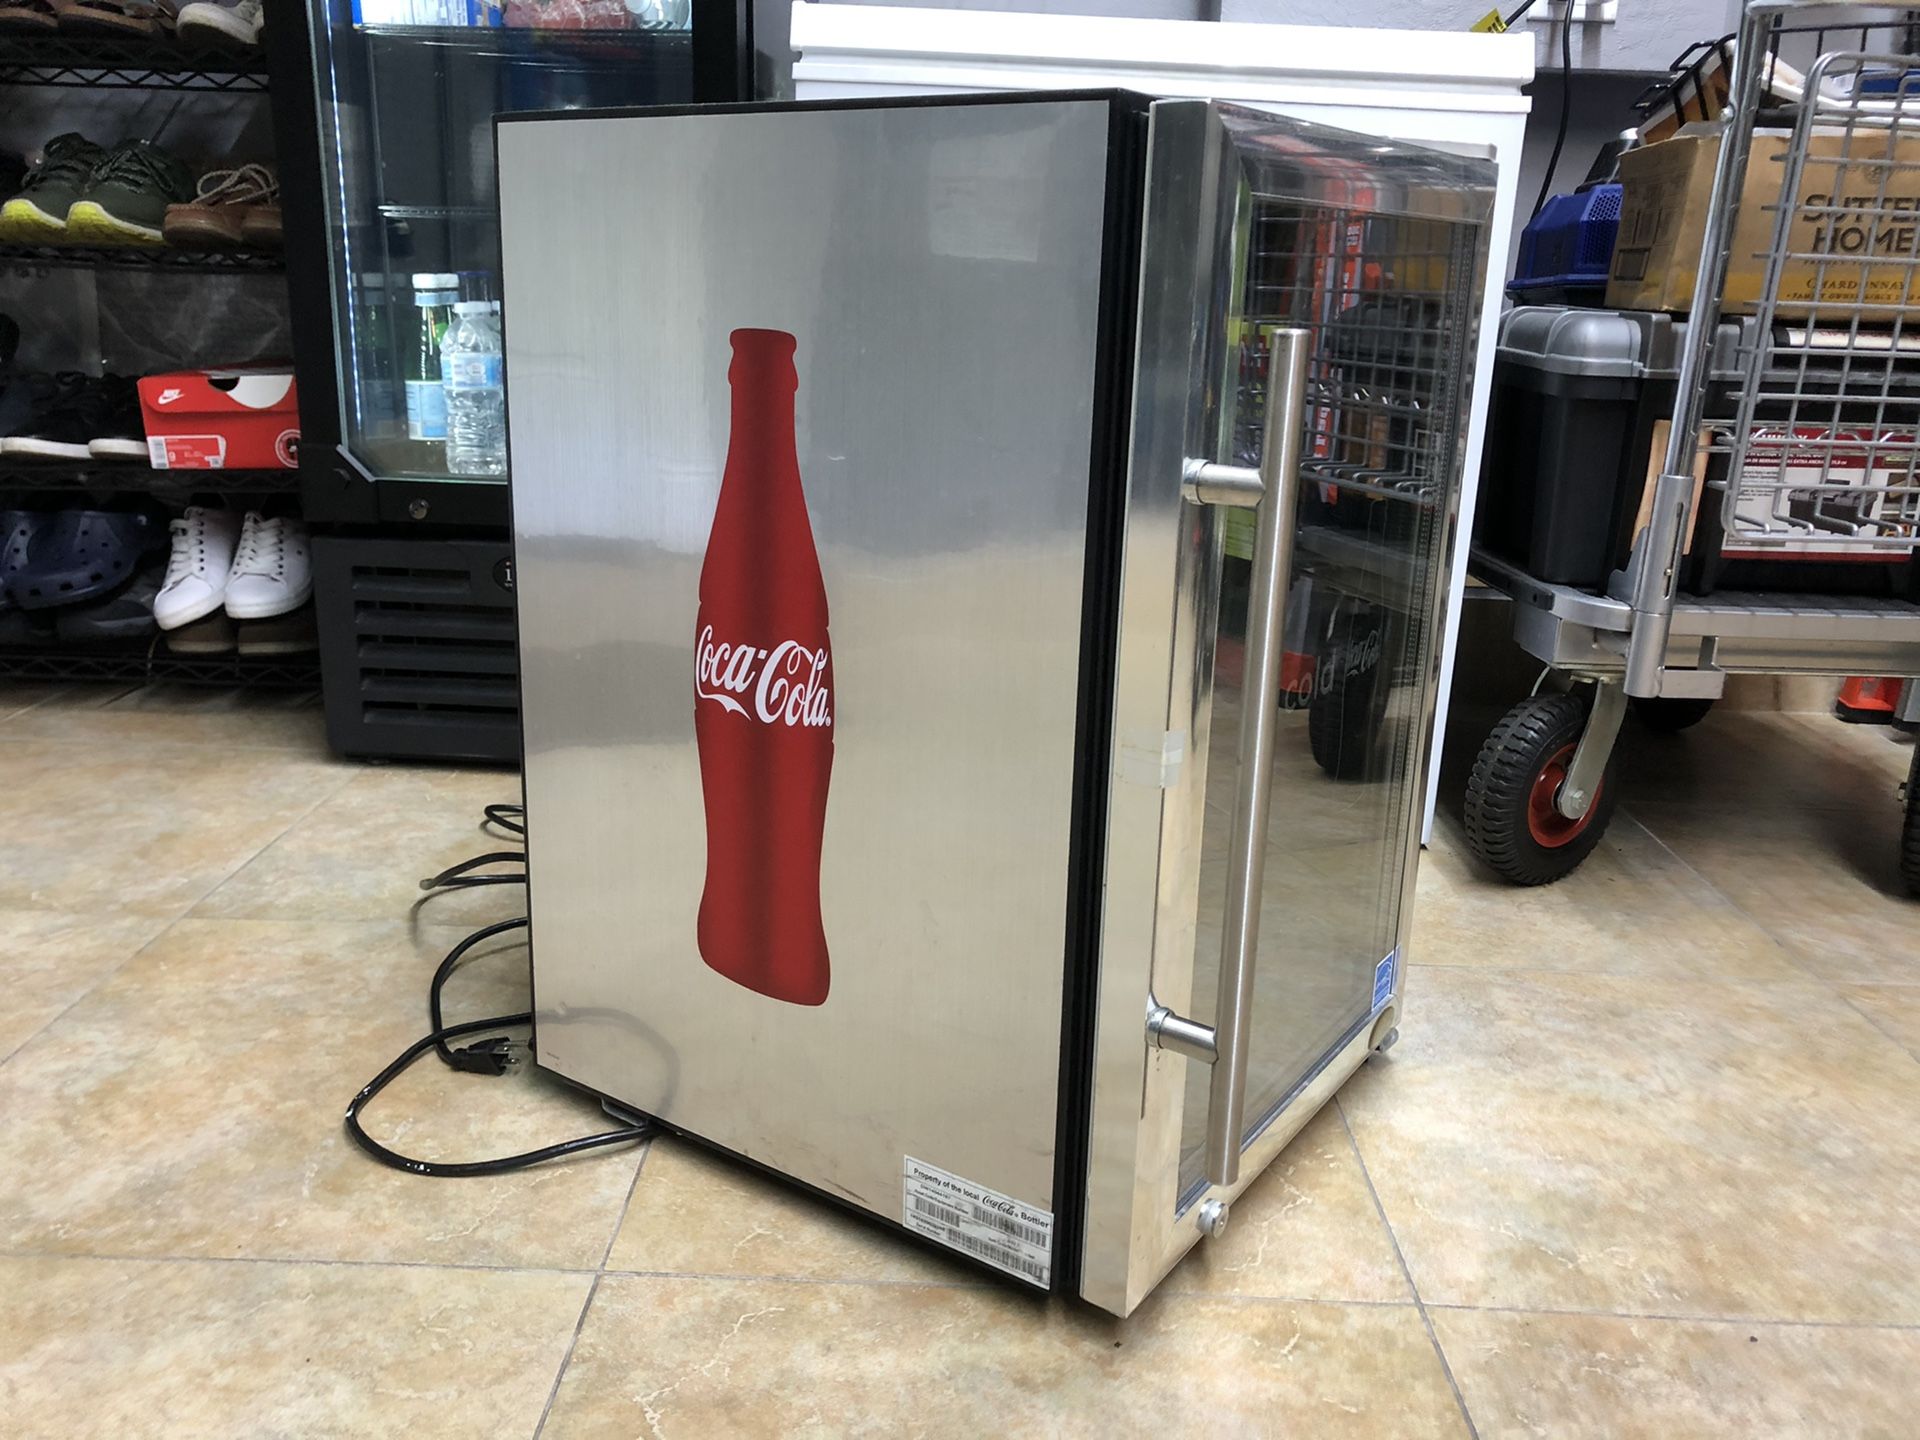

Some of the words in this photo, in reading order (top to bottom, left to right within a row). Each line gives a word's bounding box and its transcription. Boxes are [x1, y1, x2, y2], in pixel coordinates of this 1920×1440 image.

[1803, 194, 1920, 222] SUTTE
[1812, 227, 1916, 253] HOME
[1806, 278, 1905, 290] CHARDNNAY
[696, 625, 831, 727] Coca-Cola
[914, 1167, 942, 1186] Property
[950, 1184, 962, 1194] the
[963, 1188, 980, 1200] local
[1020, 1211, 1049, 1229] Bottler
